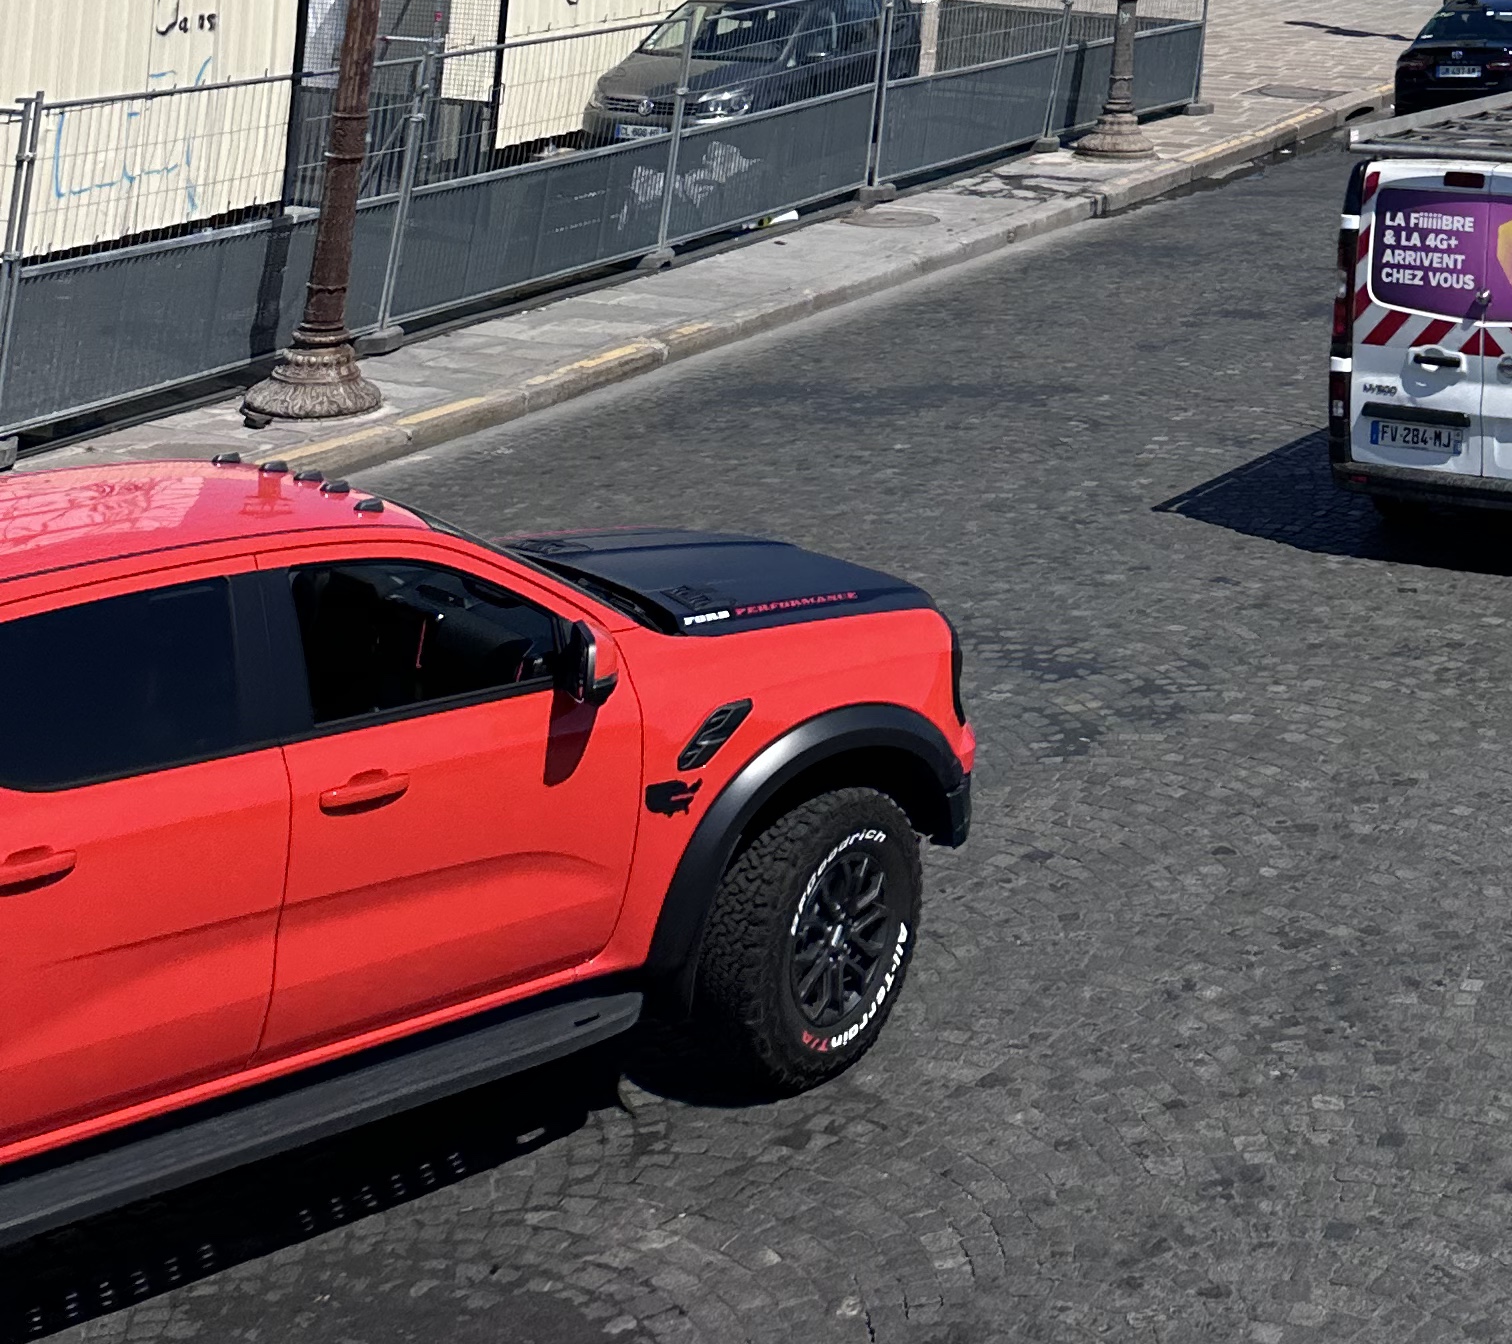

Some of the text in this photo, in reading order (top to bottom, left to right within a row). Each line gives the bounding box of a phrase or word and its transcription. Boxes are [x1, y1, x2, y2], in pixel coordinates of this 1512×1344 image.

[1384, 211, 1405, 227] LA
[1383, 230, 1459, 250] & LA 4G+
[1381, 248, 1465, 270] ARRIVENT
[1381, 267, 1475, 291] CHEZ VOUS
[1381, 424, 1451, 448] FV-284-MJ
[683, 591, 858, 626] FORD PERFORMANCE
